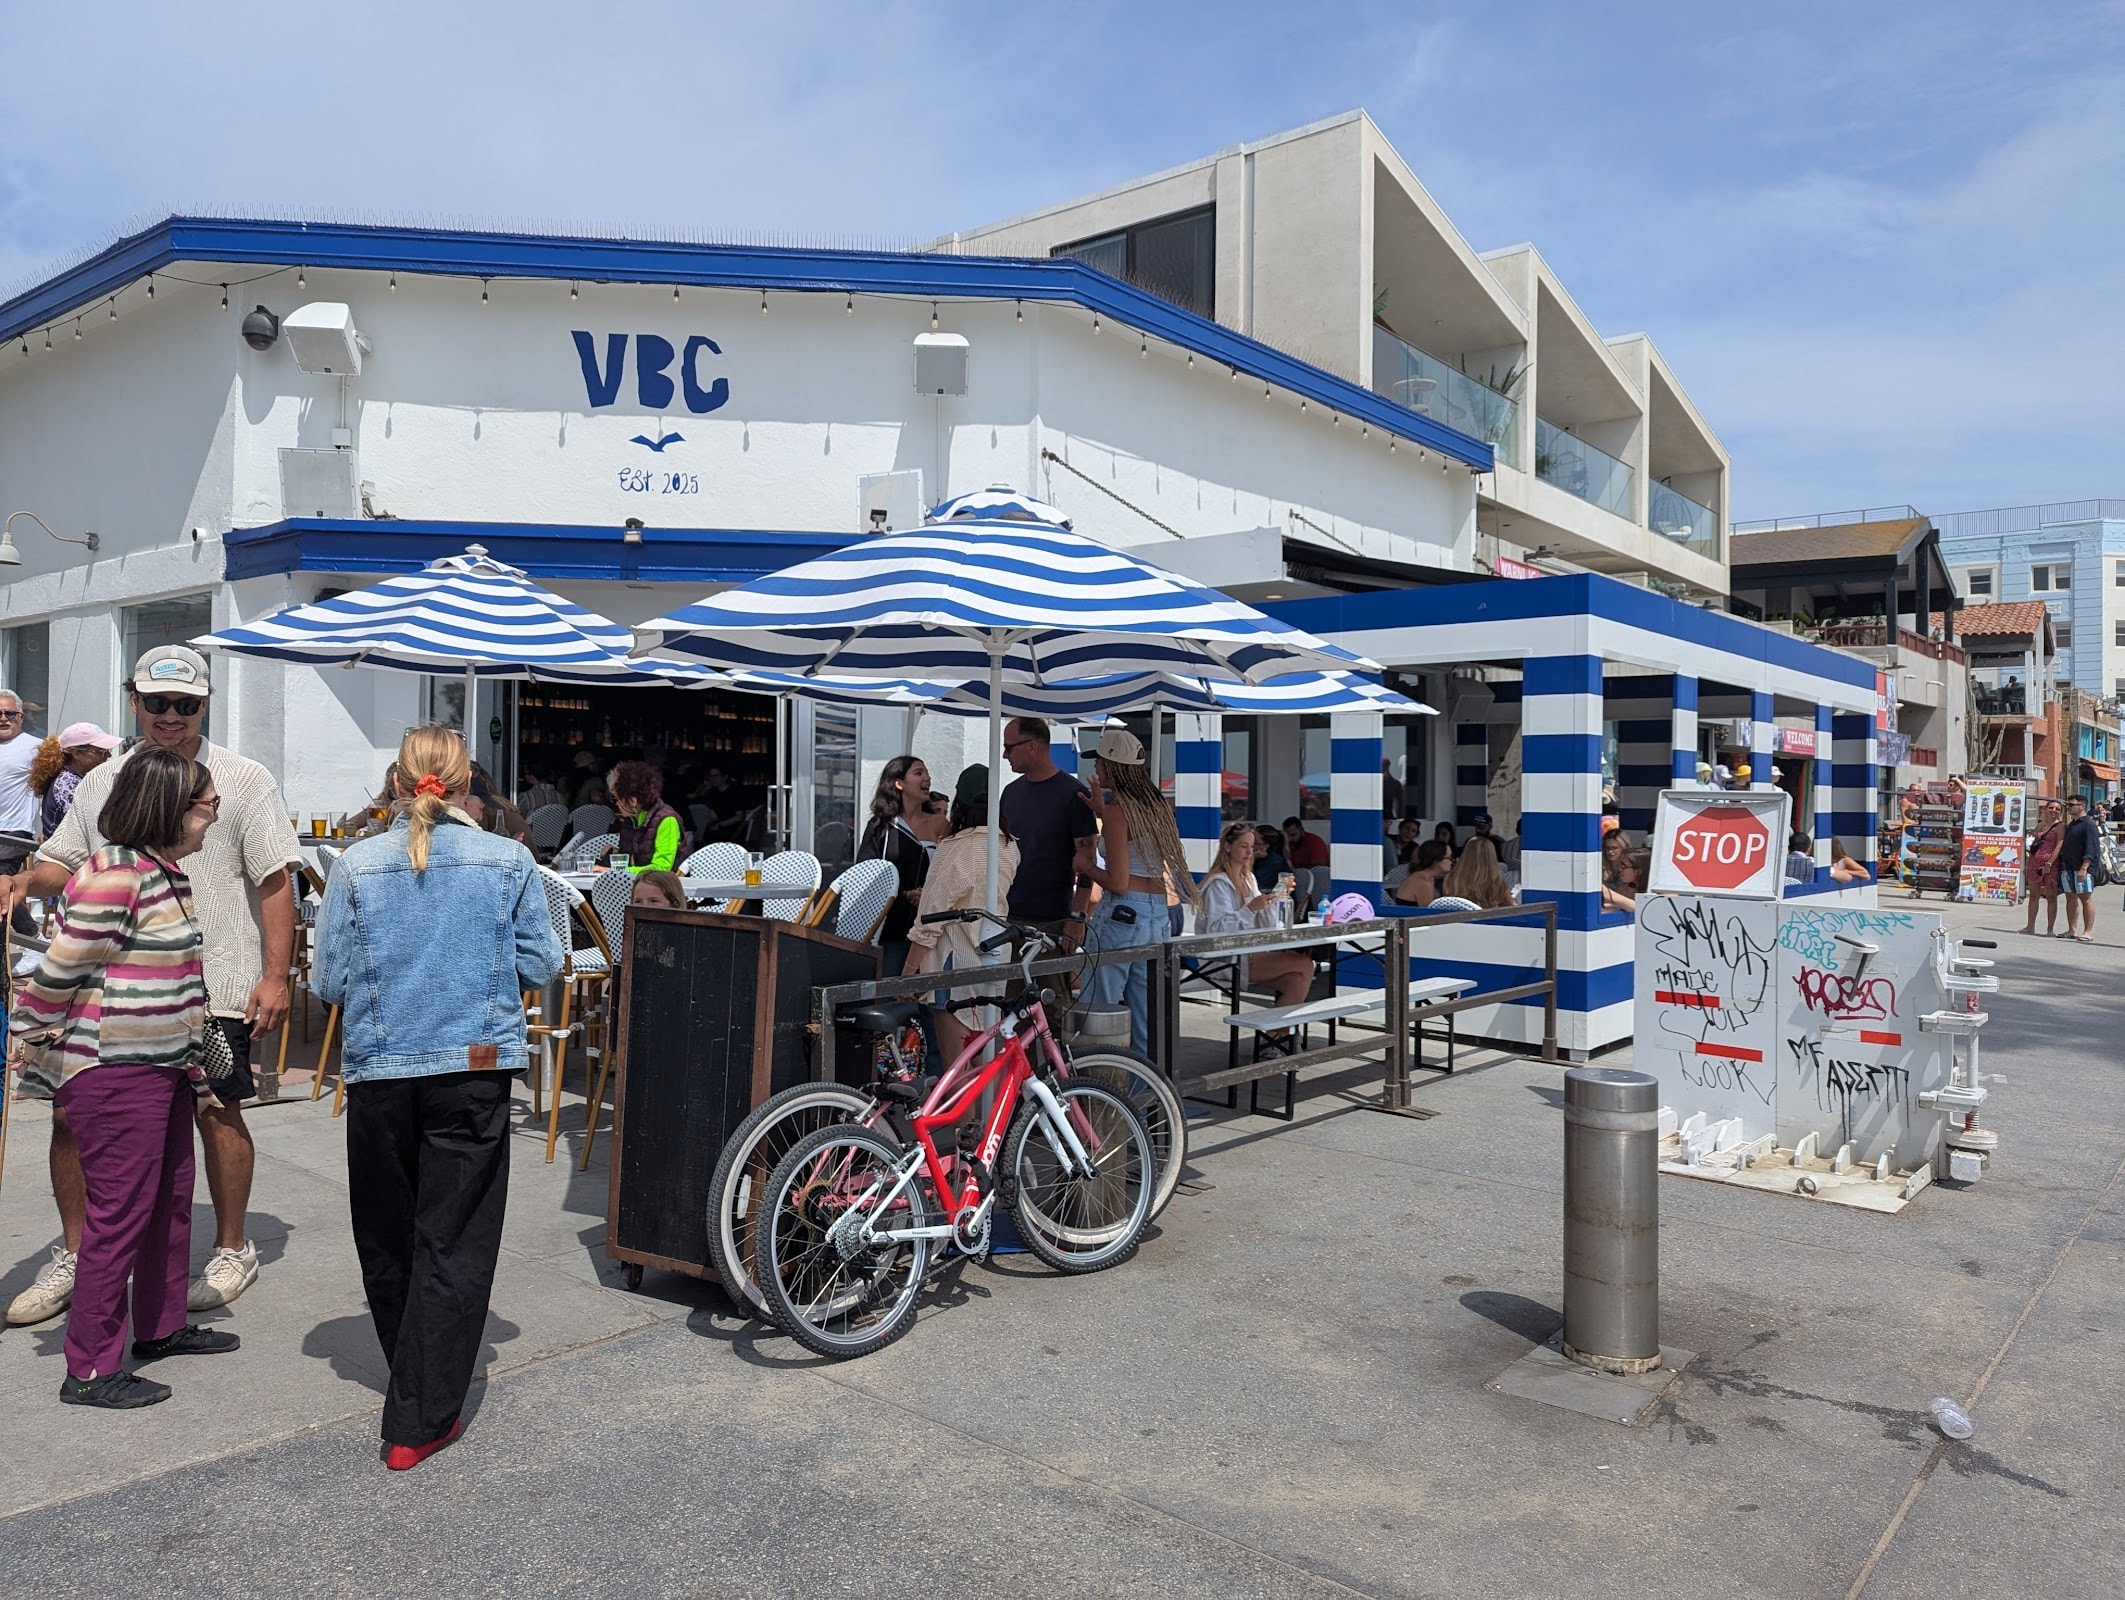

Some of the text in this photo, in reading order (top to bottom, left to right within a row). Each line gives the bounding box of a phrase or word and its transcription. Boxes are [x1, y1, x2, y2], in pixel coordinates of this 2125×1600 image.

[571, 330, 729, 414] VBC
[662, 472, 699, 495] 2025
[1786, 730, 1814, 746] WELCOME
[1675, 829, 1766, 864] STOP
[1340, 903, 1362, 920] woom
